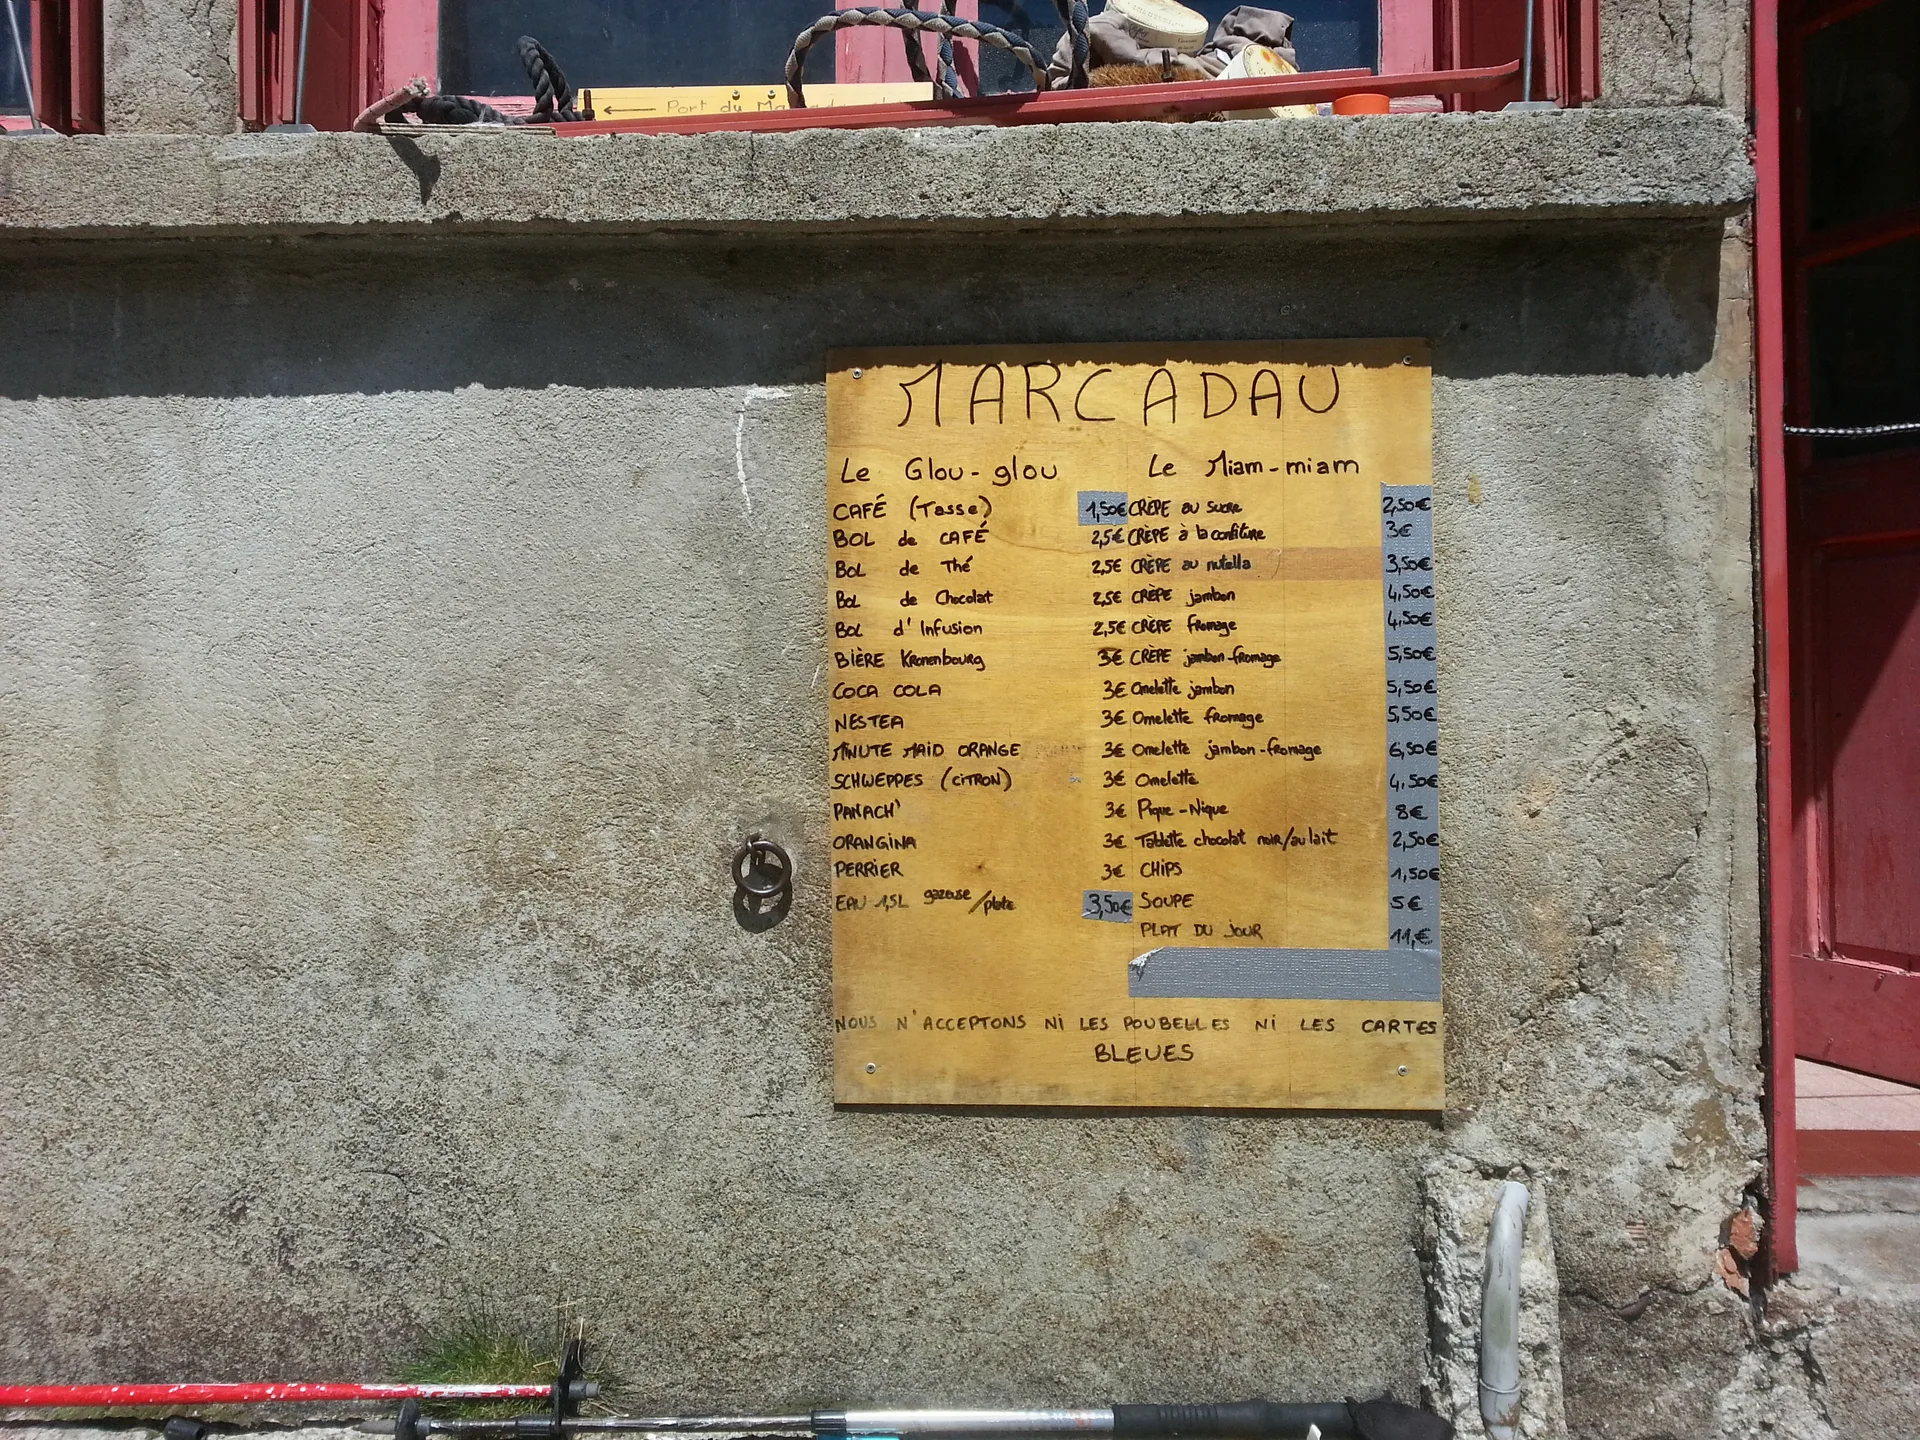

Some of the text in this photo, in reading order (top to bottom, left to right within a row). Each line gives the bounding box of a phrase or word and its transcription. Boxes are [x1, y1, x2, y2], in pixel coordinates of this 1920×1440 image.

[667, 99, 707, 114] Port
[720, 100, 743, 112] du
[898, 360, 1340, 427] MARCADAU
[841, 457, 870, 483] Le
[1149, 454, 1176, 477] Le
[833, 493, 1128, 523] CAFÉ (Tasse) 1,50€
[1181, 503, 1199, 515] au
[1383, 497, 1431, 517] 2,50€
[833, 521, 1125, 549] BOL de CAFÉ 2,5€
[1178, 523, 1188, 541] à
[1386, 520, 1412, 538] 3€
[899, 559, 920, 577] de
[940, 555, 973, 573] Thé
[1092, 559, 1122, 575] 2,5€
[1182, 559, 1198, 570] au
[1207, 554, 1251, 572] nutella
[1386, 554, 1433, 576] 3,50€
[900, 590, 918, 607] de
[935, 589, 993, 605] Chocolat
[1093, 591, 1122, 607] 2,5€
[1186, 586, 1235, 607] jambon
[1388, 584, 1434, 602] 4,50€
[1093, 620, 1126, 637] 2,5€
[1187, 614, 1237, 637] fromage
[1388, 610, 1433, 630] 4,50€
[1098, 648, 1125, 667] 3€
[1388, 646, 1436, 663] 5,50€
[833, 680, 1128, 700] COCA COLA 3€
[1131, 677, 1437, 699] Omelette jambon 5,50€
[835, 709, 1127, 732] NESTEA 3€
[1133, 705, 1437, 729] Omelette fromage 5,50€
[958, 741, 1021, 758] ORANGE
[1101, 741, 1125, 758] 3€
[1132, 740, 1190, 757] Omelette
[1389, 740, 1438, 760] 6,50€
[831, 772, 923, 790] SCHWEPPES
[1103, 770, 1126, 788] 3€
[1135, 769, 1438, 792] Omelette 4,50€
[834, 799, 1127, 821] PANACH' 3€
[1396, 804, 1428, 820] 8€
[1103, 833, 1127, 849] 3€
[1135, 829, 1187, 848] Tablette
[1193, 829, 1246, 846] chocolat
[1393, 830, 1439, 852] 2,50€
[1101, 864, 1125, 880] 3€
[1391, 867, 1440, 883] 1,50€
[835, 895, 866, 911] EAU
[874, 894, 909, 912] 1,5L
[1086, 894, 1132, 919] 3,50€
[1139, 892, 1423, 911] SOUPE 5€
[1141, 922, 1181, 938] PLAT
[1194, 923, 1213, 937] DU
[835, 1015, 877, 1033] NOUS
[1080, 1017, 1109, 1031] LES
[1124, 1016, 1230, 1031] POUBELLES
[1300, 1018, 1335, 1032] LES
[1362, 1018, 1437, 1035] CARTES
[1095, 1043, 1194, 1064] BLEUES
